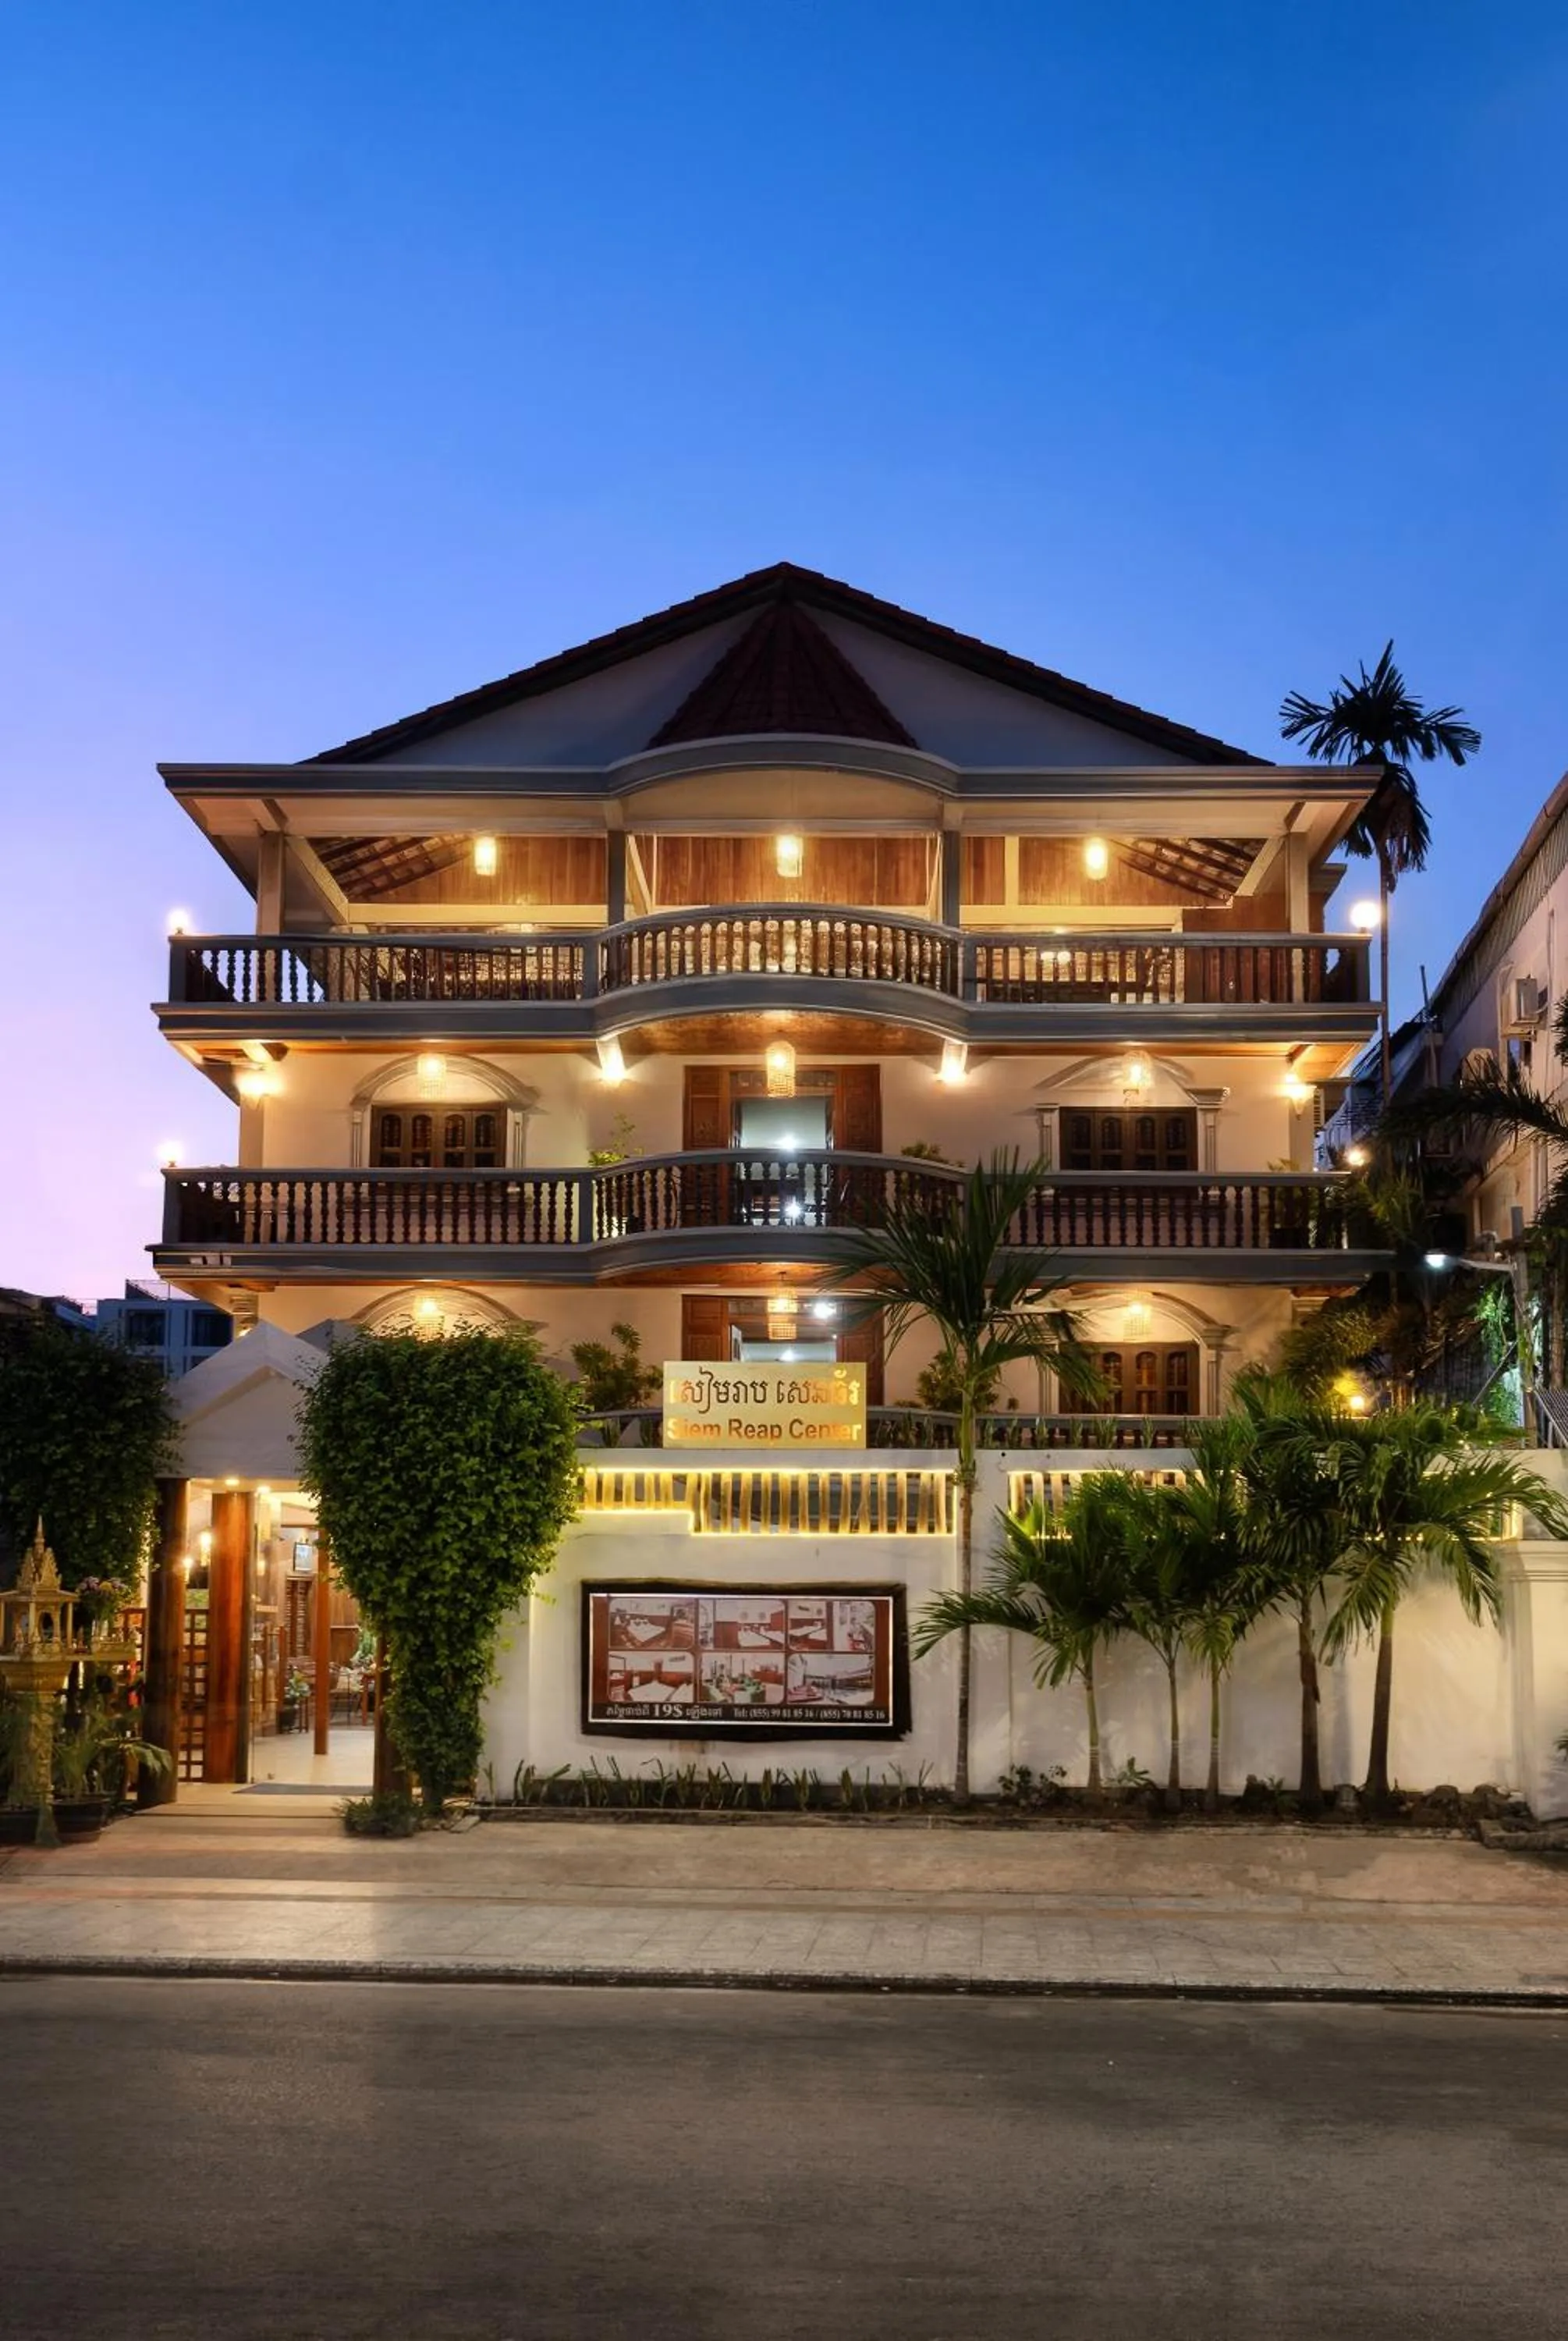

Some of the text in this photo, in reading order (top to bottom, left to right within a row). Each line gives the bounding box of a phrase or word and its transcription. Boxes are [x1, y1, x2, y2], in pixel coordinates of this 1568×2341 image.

[667, 1418, 862, 1444] Siem Reap Center
